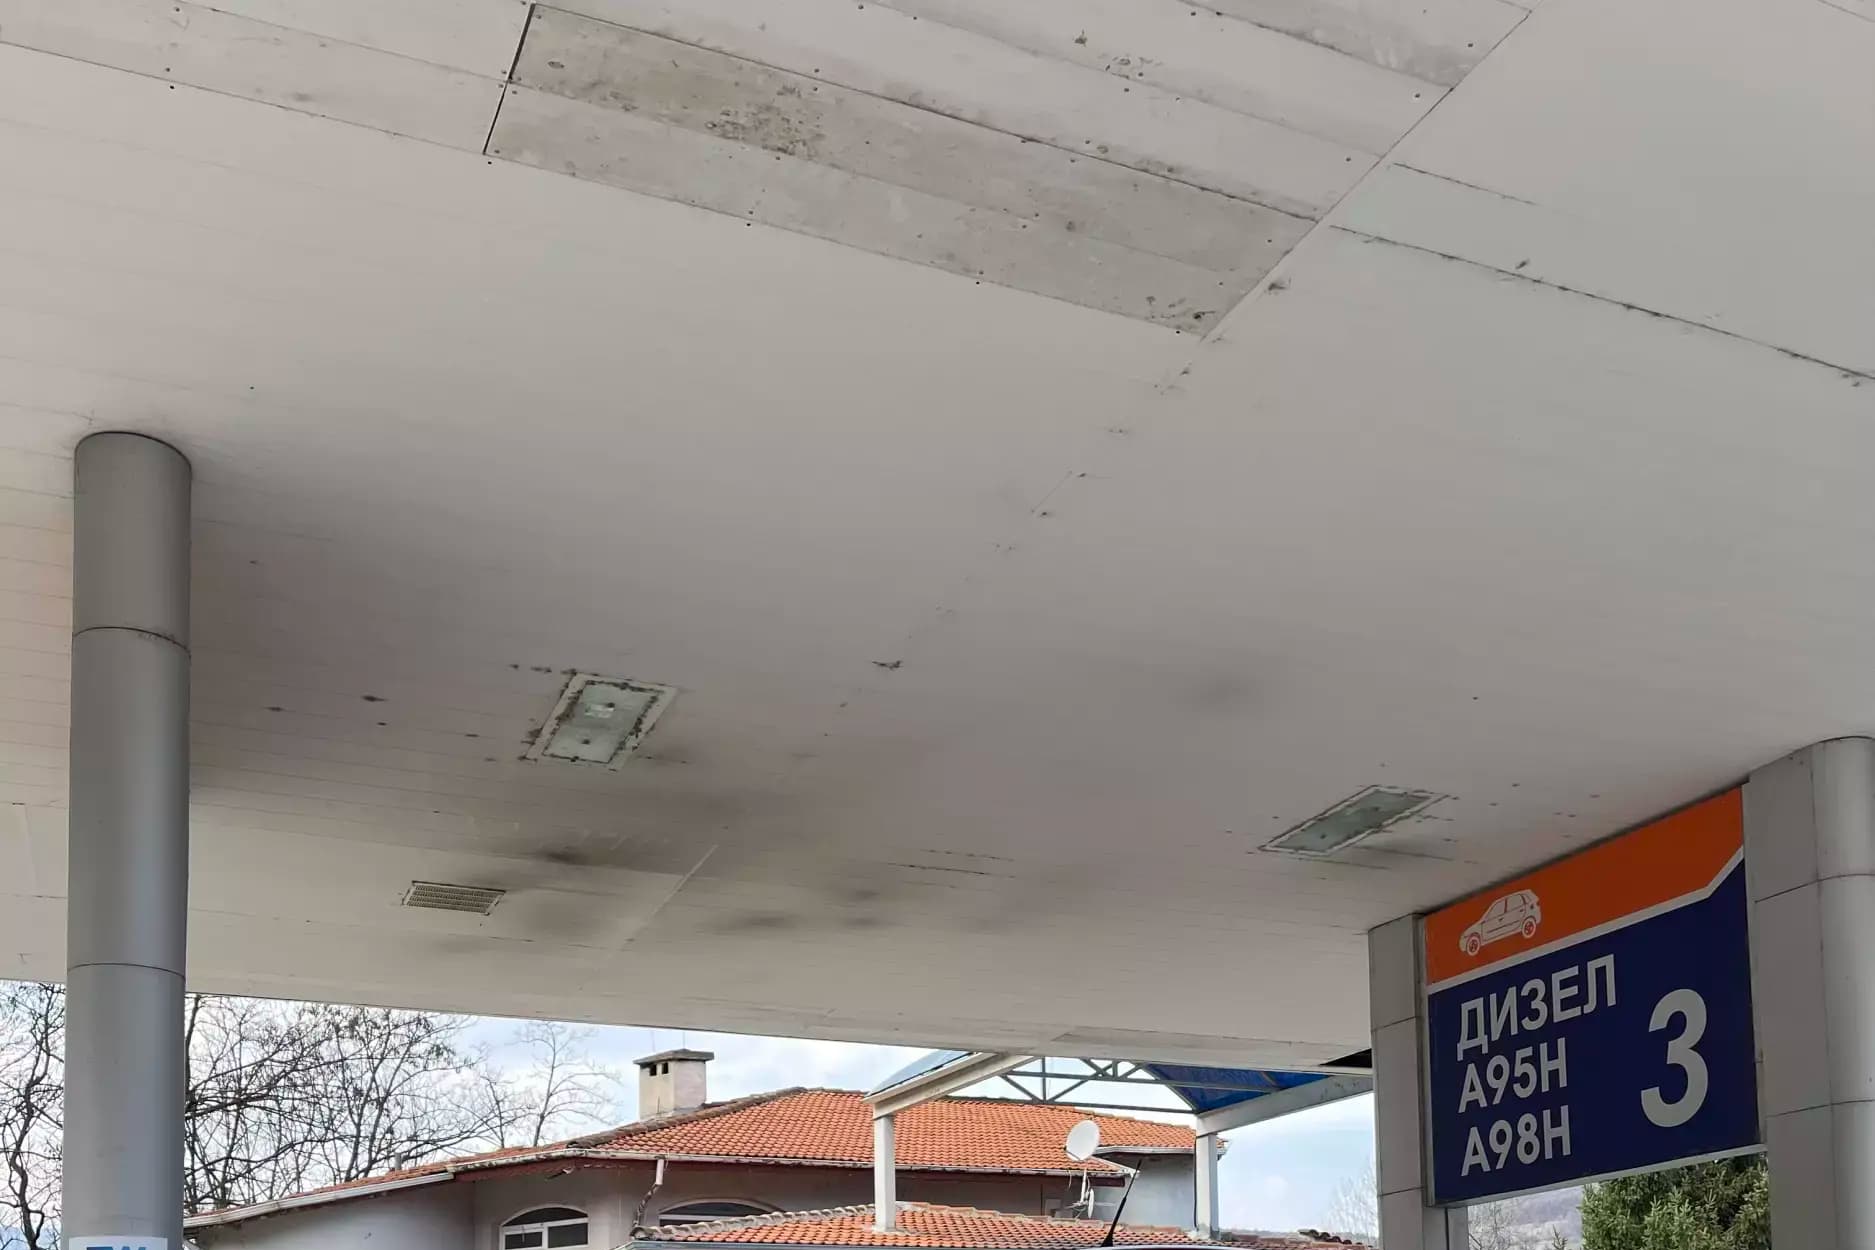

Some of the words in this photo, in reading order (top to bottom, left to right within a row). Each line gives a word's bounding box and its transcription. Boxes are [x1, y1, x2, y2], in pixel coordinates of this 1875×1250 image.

[1457, 954, 1616, 1061] ДИЗЕЛ
[1458, 1037, 1568, 1113] А95Н
[1640, 988, 1709, 1128] 3
[1460, 1104, 1572, 1177] А98Н
